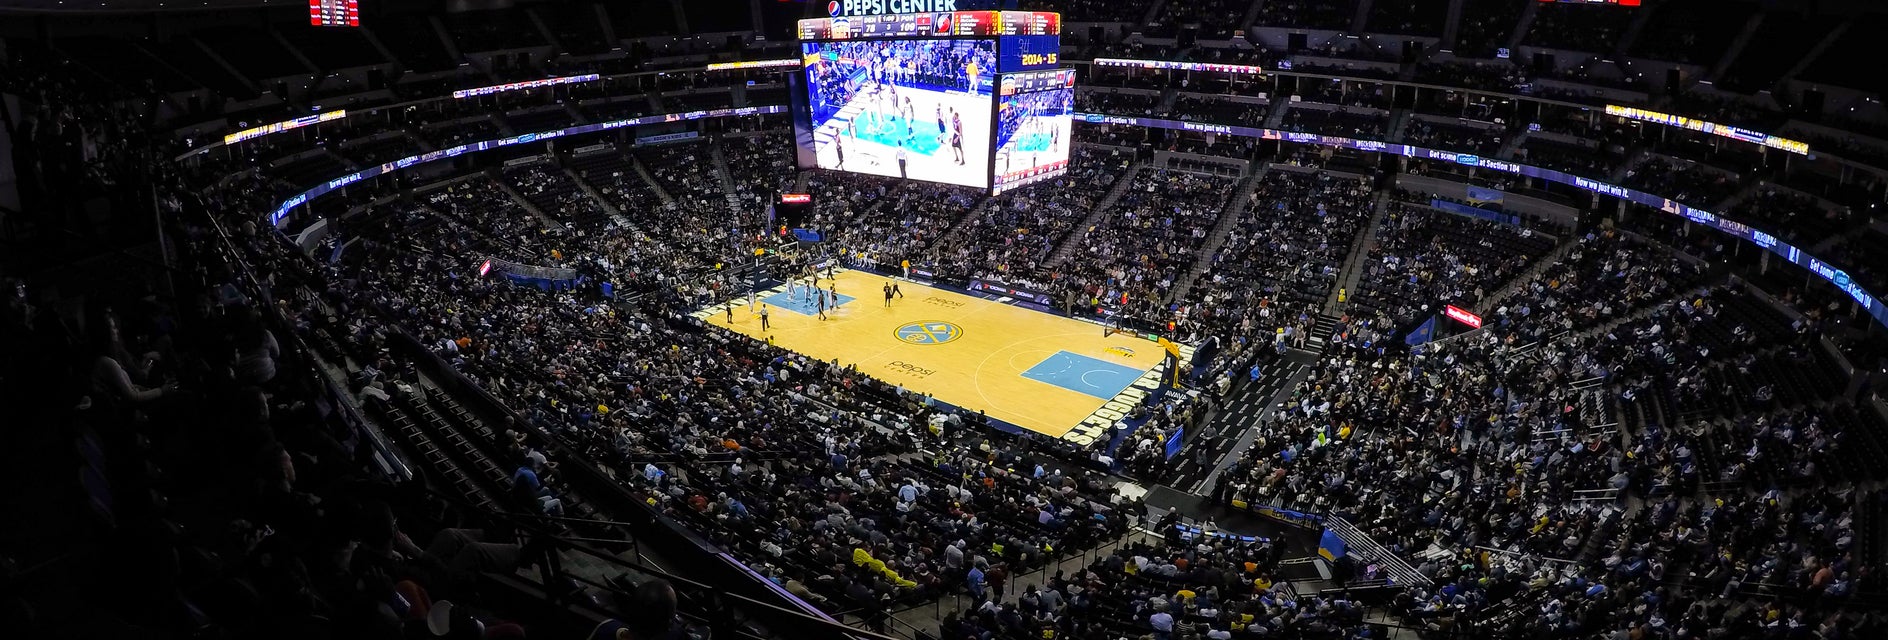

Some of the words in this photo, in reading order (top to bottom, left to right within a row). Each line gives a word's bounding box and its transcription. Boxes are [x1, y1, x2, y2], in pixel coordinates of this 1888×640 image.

[843, 0, 887, 16] PEPSI
[890, 0, 957, 13] CENTER
[1429, 150, 1440, 159] Get
[1440, 152, 1457, 161] some
[1479, 159, 1486, 167] at
[1486, 160, 1508, 171] Section
[1509, 164, 1520, 173] 104
[1575, 176, 1589, 187] Now
[1588, 181, 1598, 190] we
[1597, 182, 1610, 193] just
[1610, 186, 1622, 197] win
[889, 360, 937, 376] pepsi
[1164, 389, 1188, 400] AVAYA
[1063, 385, 1147, 446] NUGGETS
